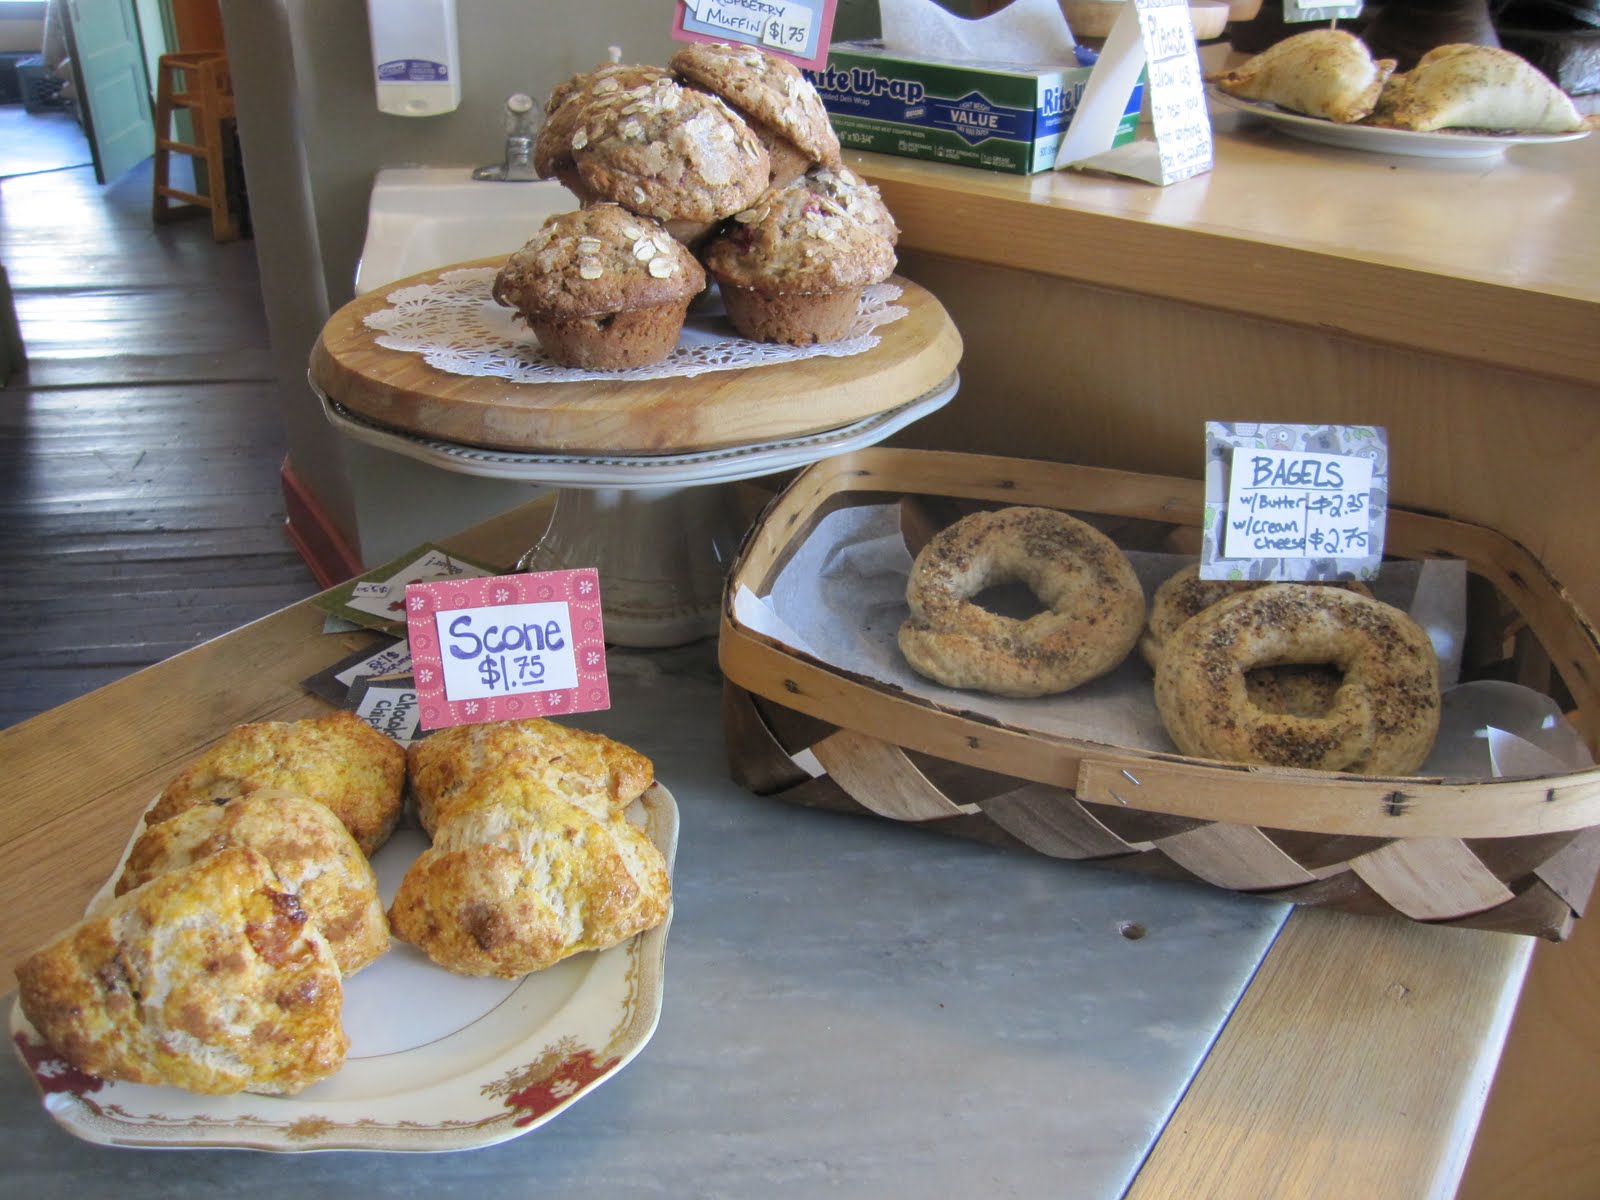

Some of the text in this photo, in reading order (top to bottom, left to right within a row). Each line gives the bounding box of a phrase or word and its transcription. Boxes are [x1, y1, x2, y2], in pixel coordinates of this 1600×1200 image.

[769, 20, 806, 44] $1.75
[1147, 14, 1185, 56] Please
[820, 93, 839, 102] olded
[1043, 80, 1087, 116] RiteW
[950, 109, 999, 128] VALUE
[1251, 456, 1344, 488] BAGELS
[1308, 527, 1369, 553] $2.75
[449, 615, 565, 660] Scone
[478, 654, 545, 691] $1.75
